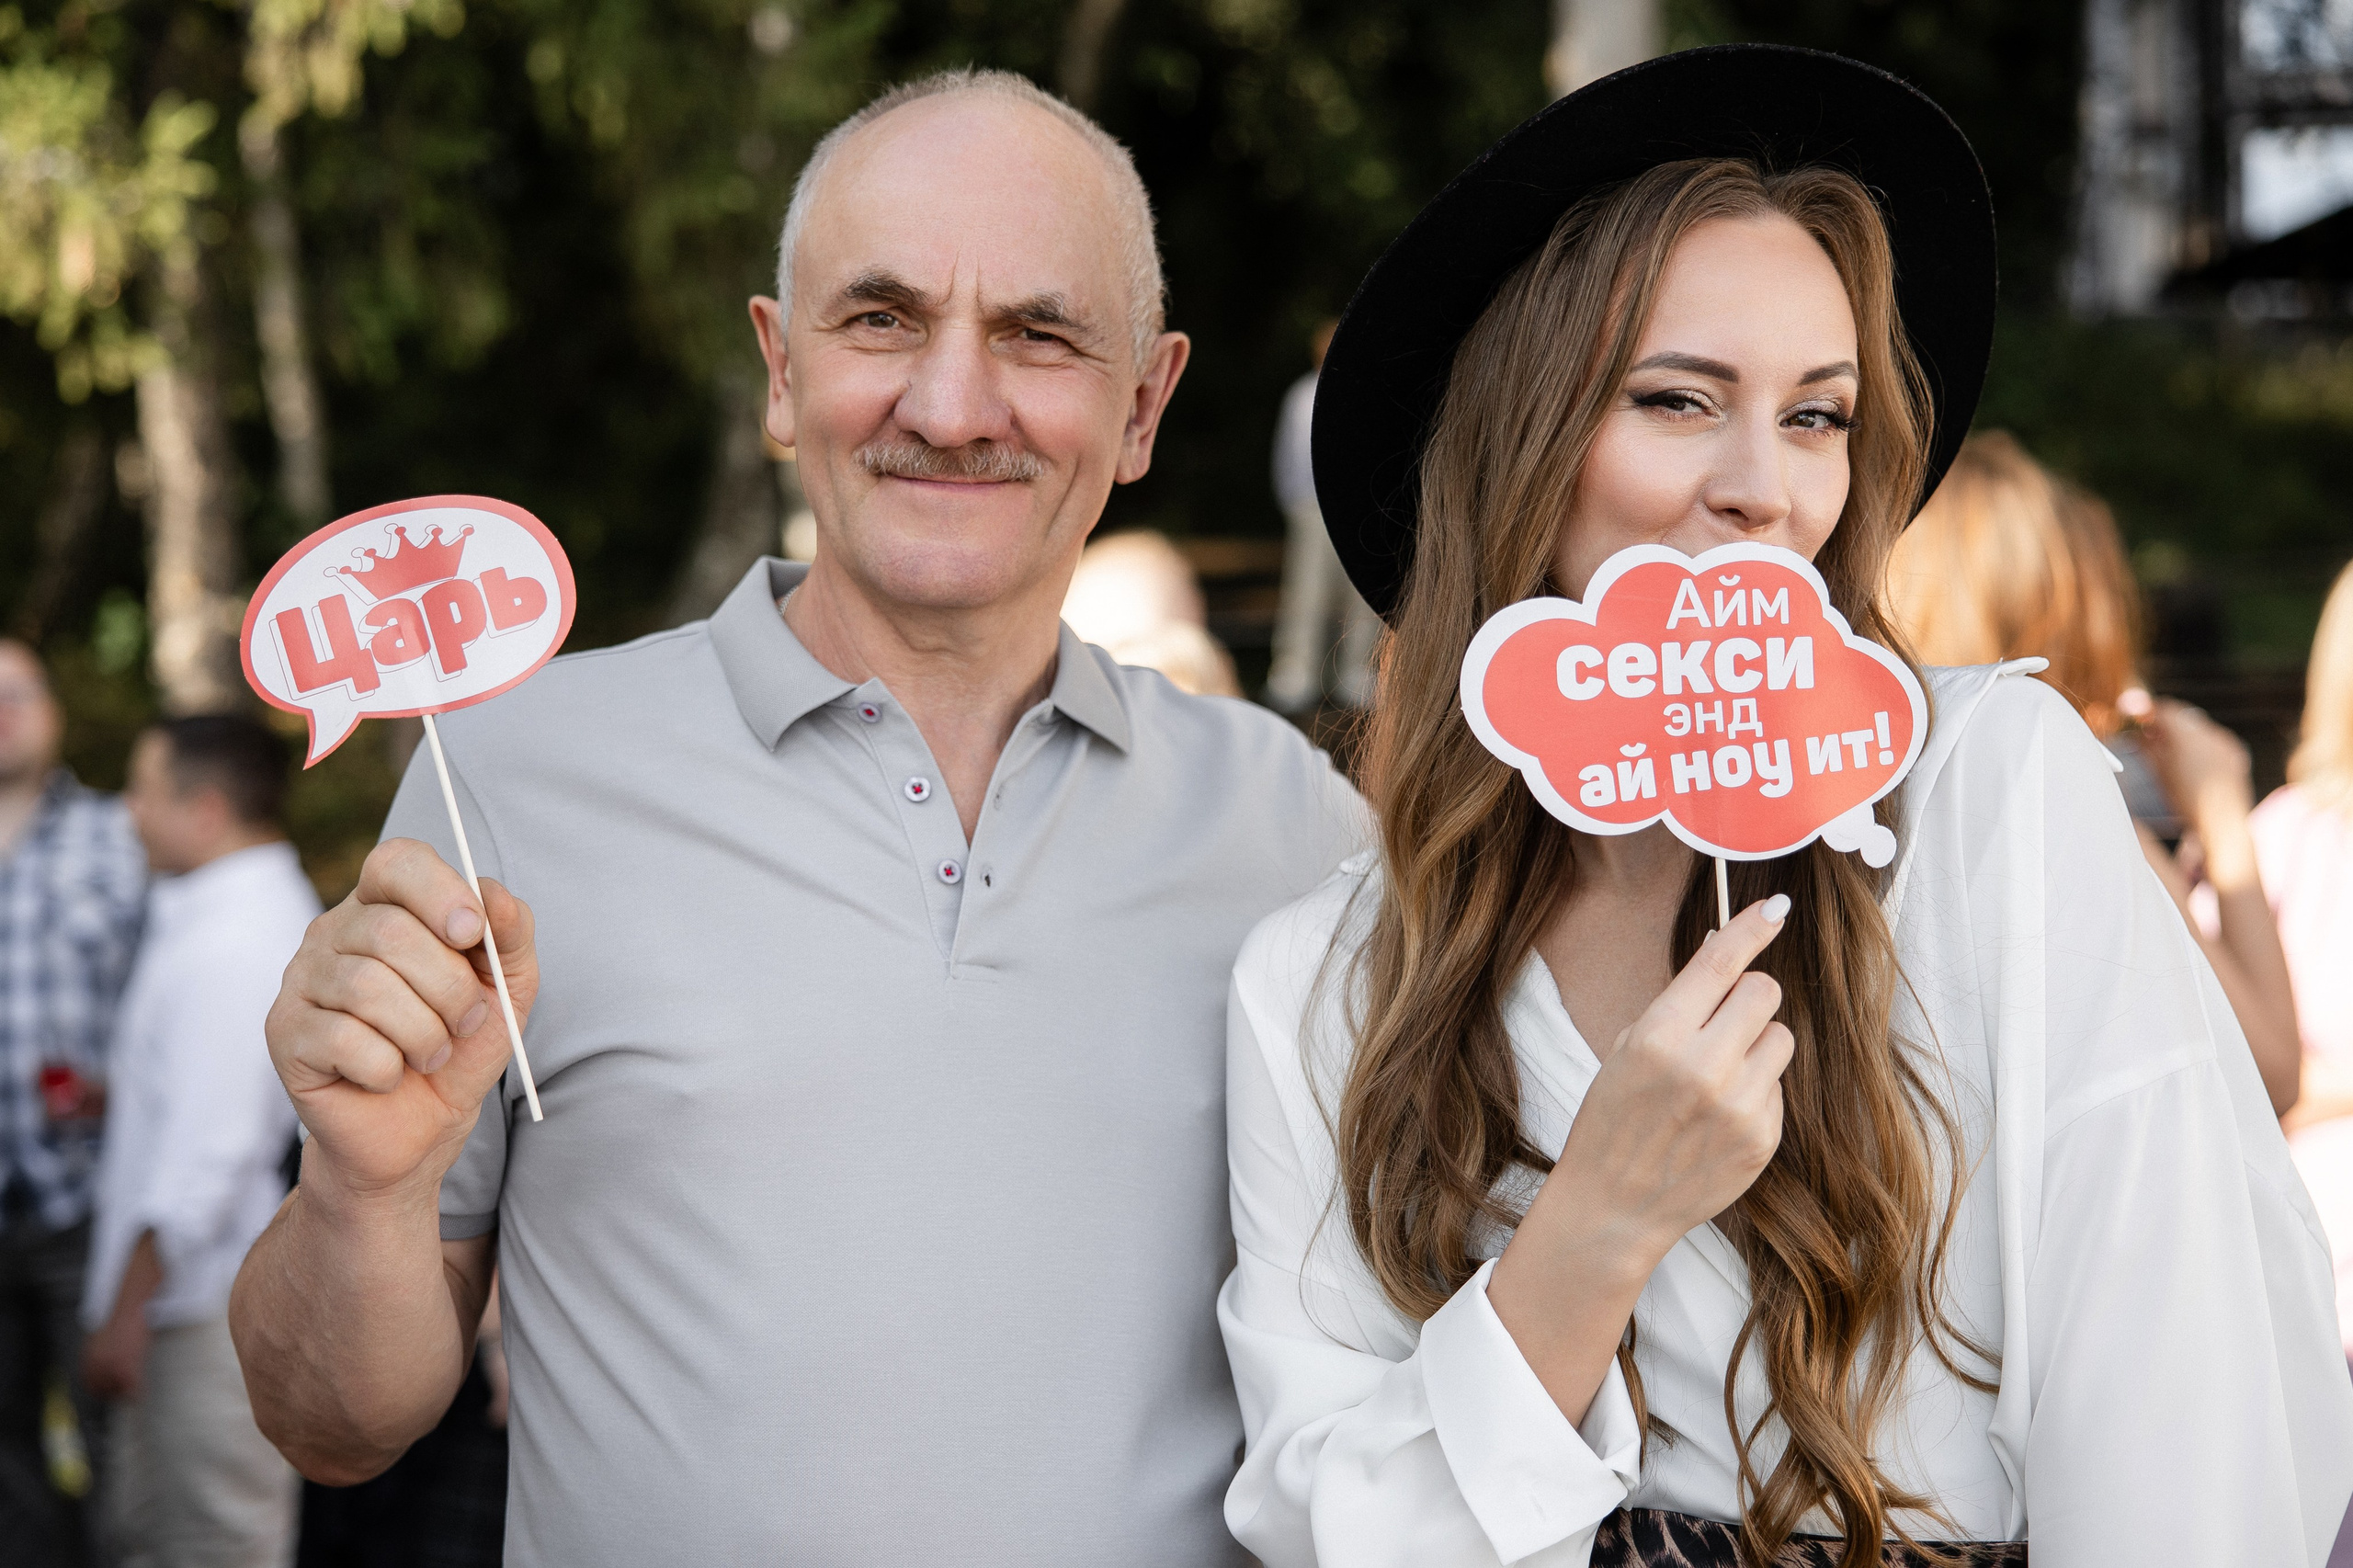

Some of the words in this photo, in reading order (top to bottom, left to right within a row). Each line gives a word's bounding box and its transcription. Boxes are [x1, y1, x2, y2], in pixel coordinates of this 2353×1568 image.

[274, 566, 548, 695] Царь
[1665, 574, 1790, 630] Айм
[1555, 636, 1815, 701] секси
[1663, 698, 1763, 738] энд
[1577, 743, 1658, 808] ай
[1669, 739, 1794, 798] ноу
[1805, 711, 1894, 776] ит!
